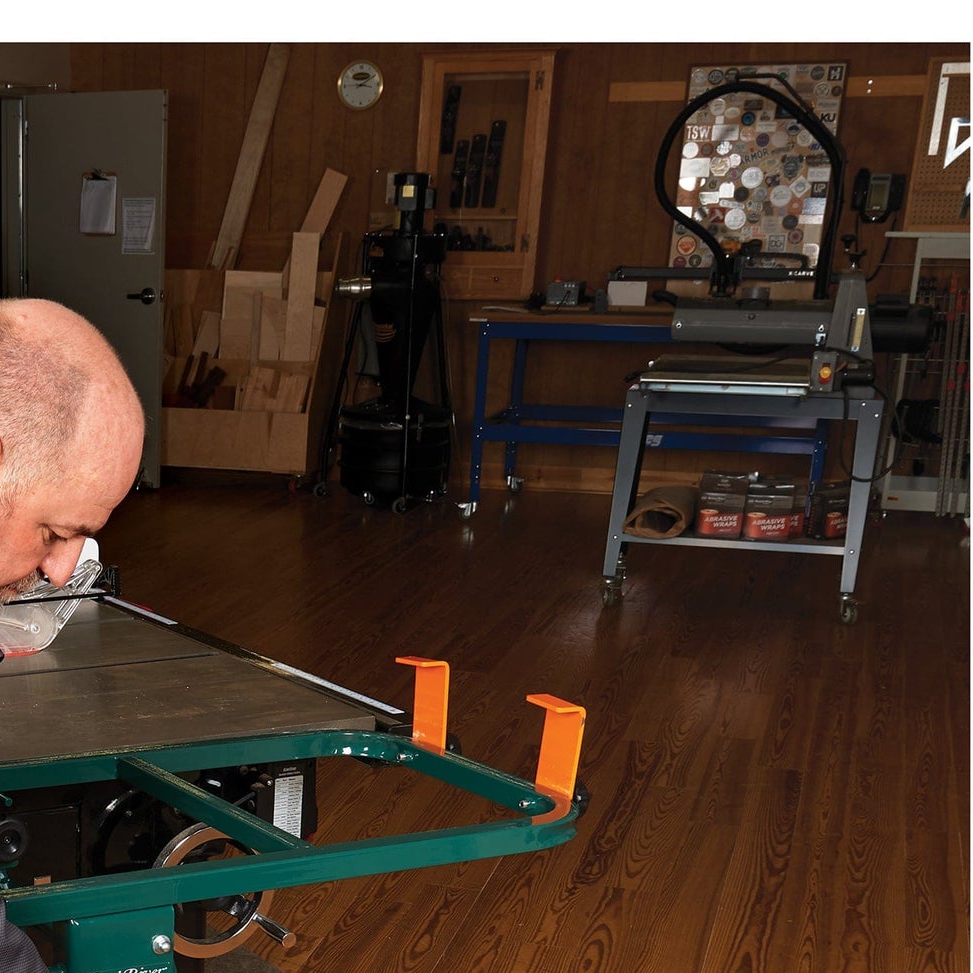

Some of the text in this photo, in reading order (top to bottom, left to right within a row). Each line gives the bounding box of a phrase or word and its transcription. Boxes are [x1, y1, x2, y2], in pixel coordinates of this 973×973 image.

[687, 125, 711, 140] TSW
[704, 515, 739, 523] ABRASIVE
[751, 518, 787, 526] ABRASIVE
[712, 520, 738, 528] WRAPS
[760, 523, 786, 531] WRAPS
